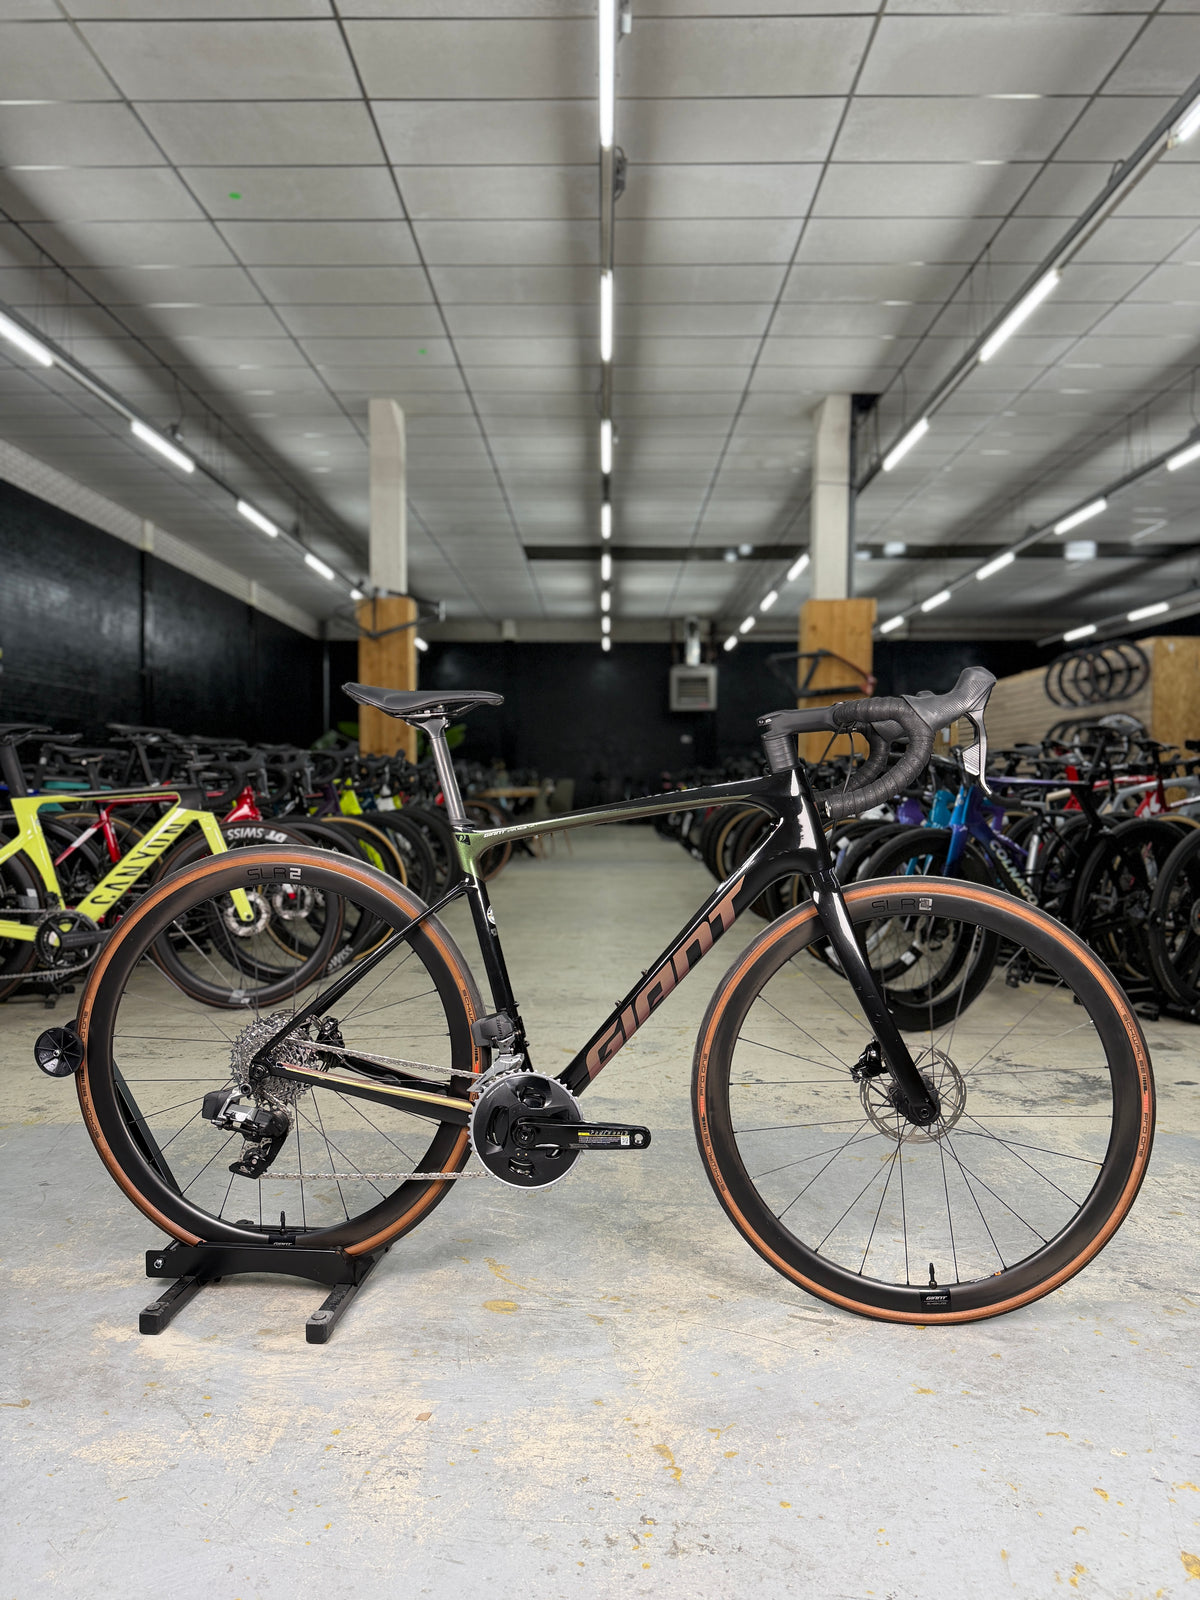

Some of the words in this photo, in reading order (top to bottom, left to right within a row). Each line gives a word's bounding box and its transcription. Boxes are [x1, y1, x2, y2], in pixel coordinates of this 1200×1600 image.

[90, 823, 186, 905] CANYON
[227, 827, 264, 840] SWISS
[265, 830, 288, 843] DT
[989, 840, 1039, 906] COLNAGO
[586, 875, 746, 1082] GIANT
[1122, 1013, 1147, 1075] SCHWALBE
[704, 1134, 727, 1192] SCHWALBE
